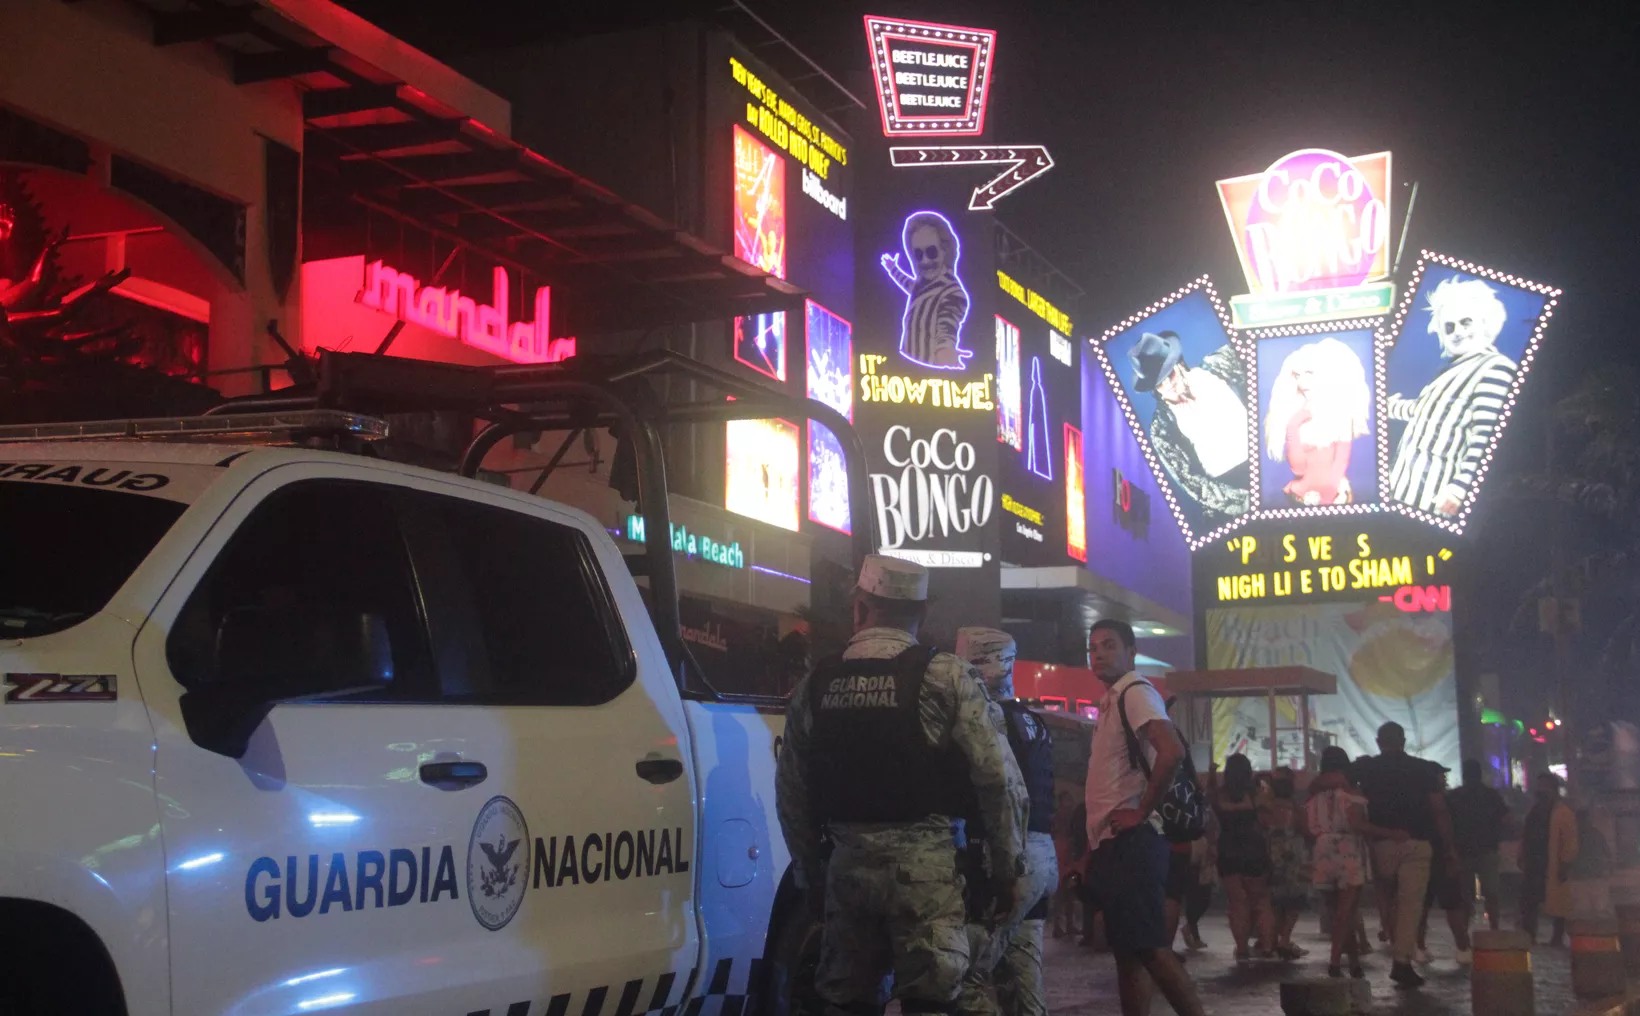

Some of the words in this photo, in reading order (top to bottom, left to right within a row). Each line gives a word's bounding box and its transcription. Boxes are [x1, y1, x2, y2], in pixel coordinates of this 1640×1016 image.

[892, 50, 968, 69] BEETLEJUICE
[895, 72, 967, 89] BEETLEJUICE
[900, 93, 962, 108] BEETLEJUICE
[758, 105, 789, 150] ROLLED
[789, 129, 808, 165] INTO
[802, 167, 847, 221] billboard
[869, 464, 994, 548] BONGO
[699, 535, 744, 569] Beach
[926, 552, 937, 565] &
[940, 552, 975, 566] Disco
[1318, 566, 1346, 591] TO
[829, 675, 896, 693] GUARDIA
[820, 690, 899, 710] NACIONAL
[244, 845, 459, 922] GUARDIA
[532, 827, 690, 889] NACIONAL
